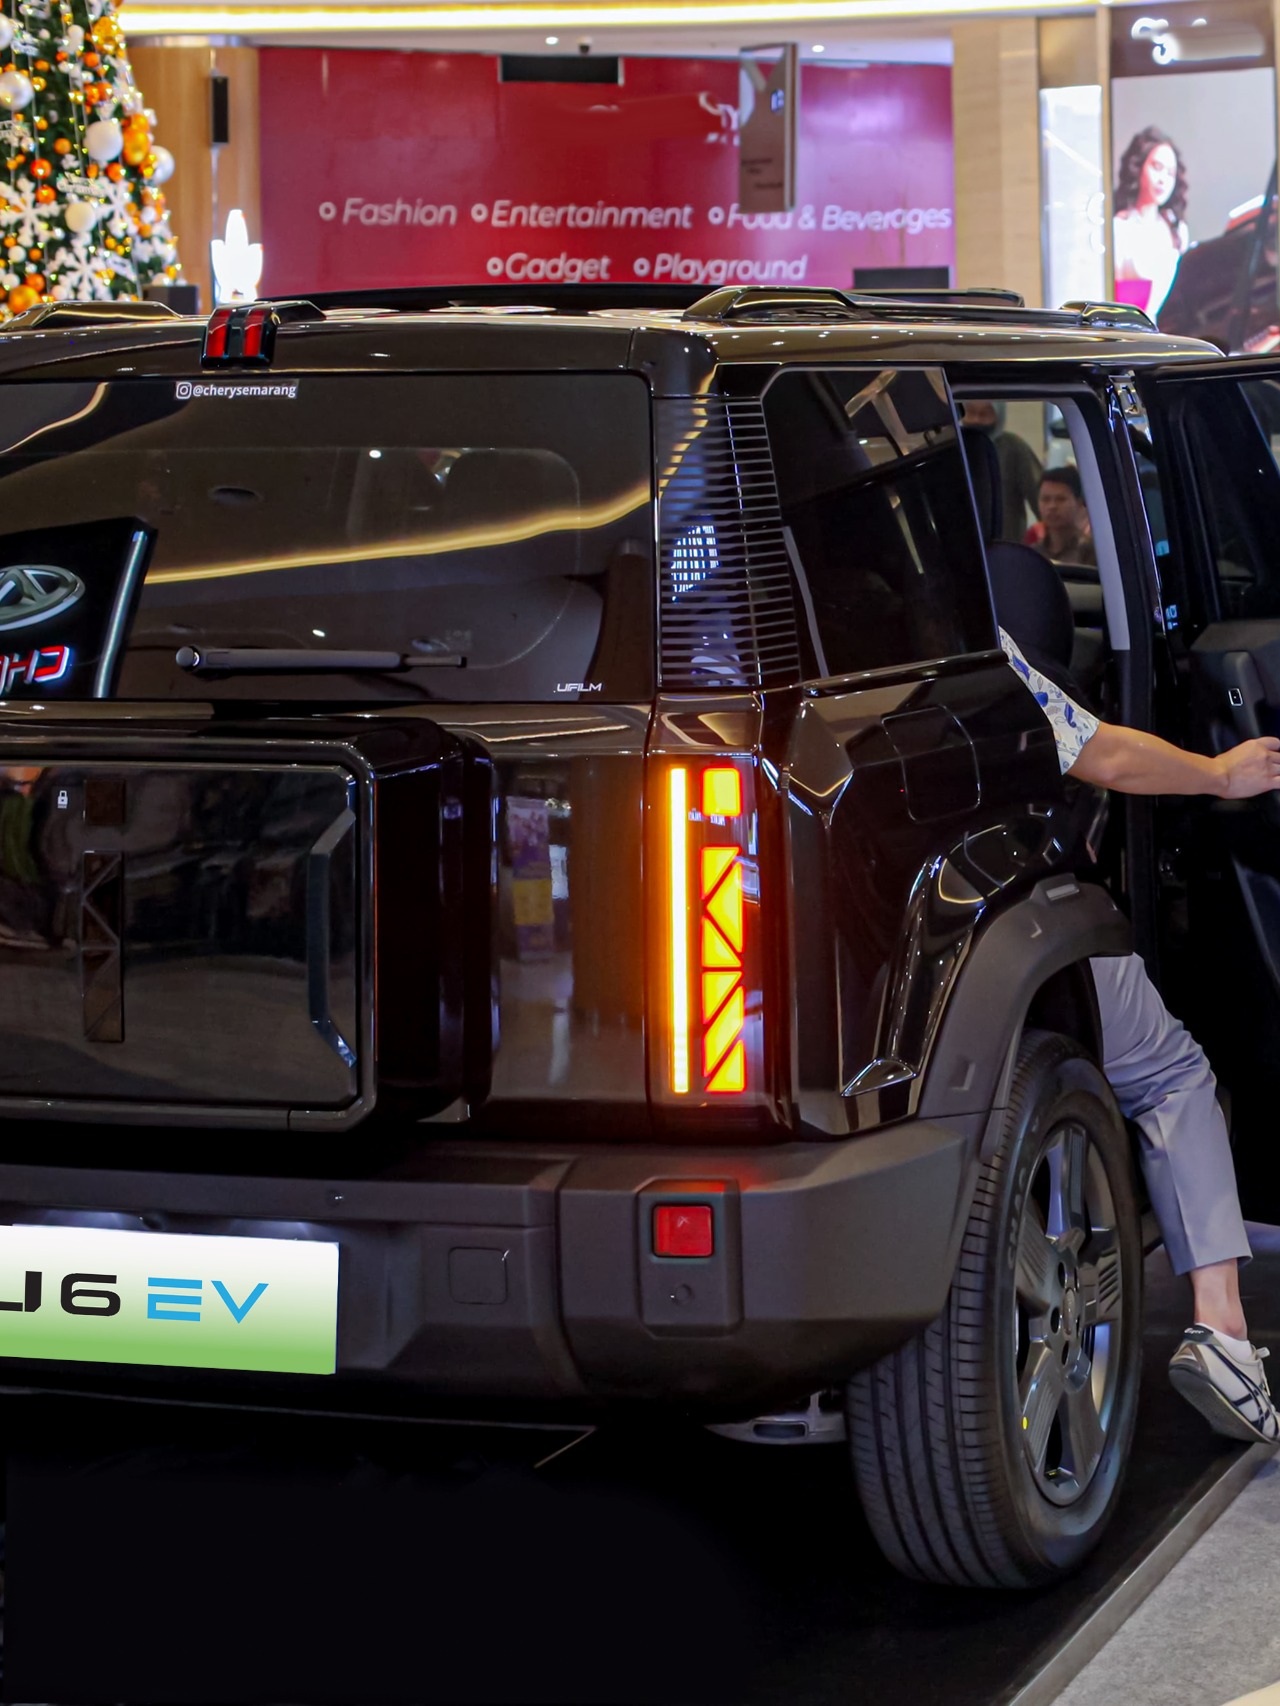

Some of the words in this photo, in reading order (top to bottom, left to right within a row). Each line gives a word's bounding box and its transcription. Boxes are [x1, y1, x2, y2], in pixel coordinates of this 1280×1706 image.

[342, 198, 458, 226] Fashion
[491, 199, 693, 229] Entertainment
[798, 204, 815, 230] &
[822, 204, 952, 235] Beverages
[505, 252, 611, 283] Gadget
[653, 252, 808, 284] Playground
[193, 384, 297, 399] @cherysemarang
[557, 683, 602, 692] UFILM
[147, 1277, 269, 1324] EV
